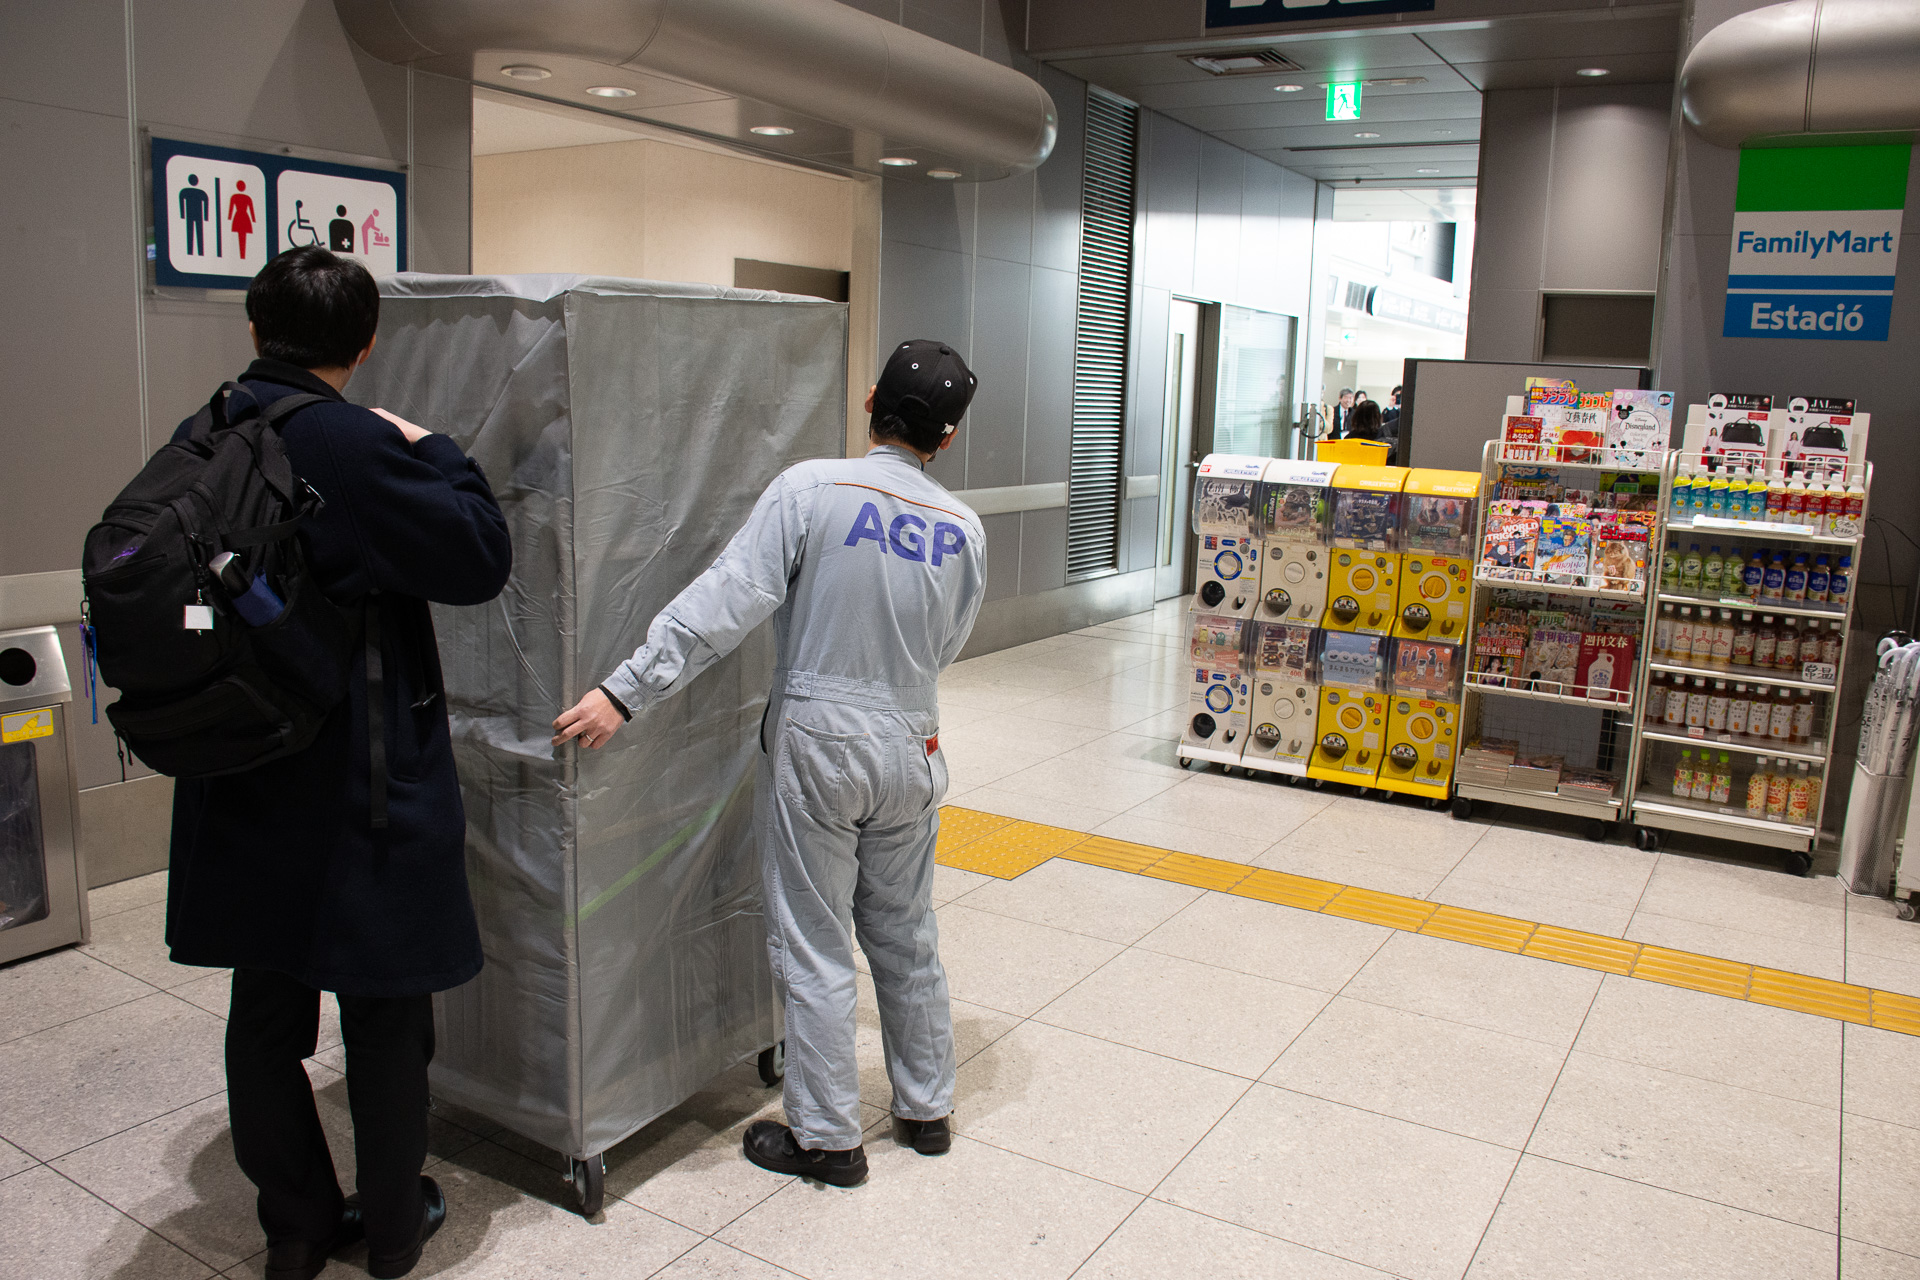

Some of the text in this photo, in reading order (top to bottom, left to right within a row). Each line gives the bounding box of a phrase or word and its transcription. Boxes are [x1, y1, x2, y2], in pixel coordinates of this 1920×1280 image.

[1737, 230, 1893, 259] FamilyMart
[1750, 302, 1864, 332] Estació
[1542, 393, 1578, 404] ナンプレ
[1625, 422, 1656, 431] Disneyland
[843, 501, 967, 567] AGP
[1503, 522, 1539, 533] WORLD
[1534, 630, 1581, 644] 週刊新潮
[1584, 634, 1628, 649] 週刊文春
[1804, 664, 1834, 680] 常温
